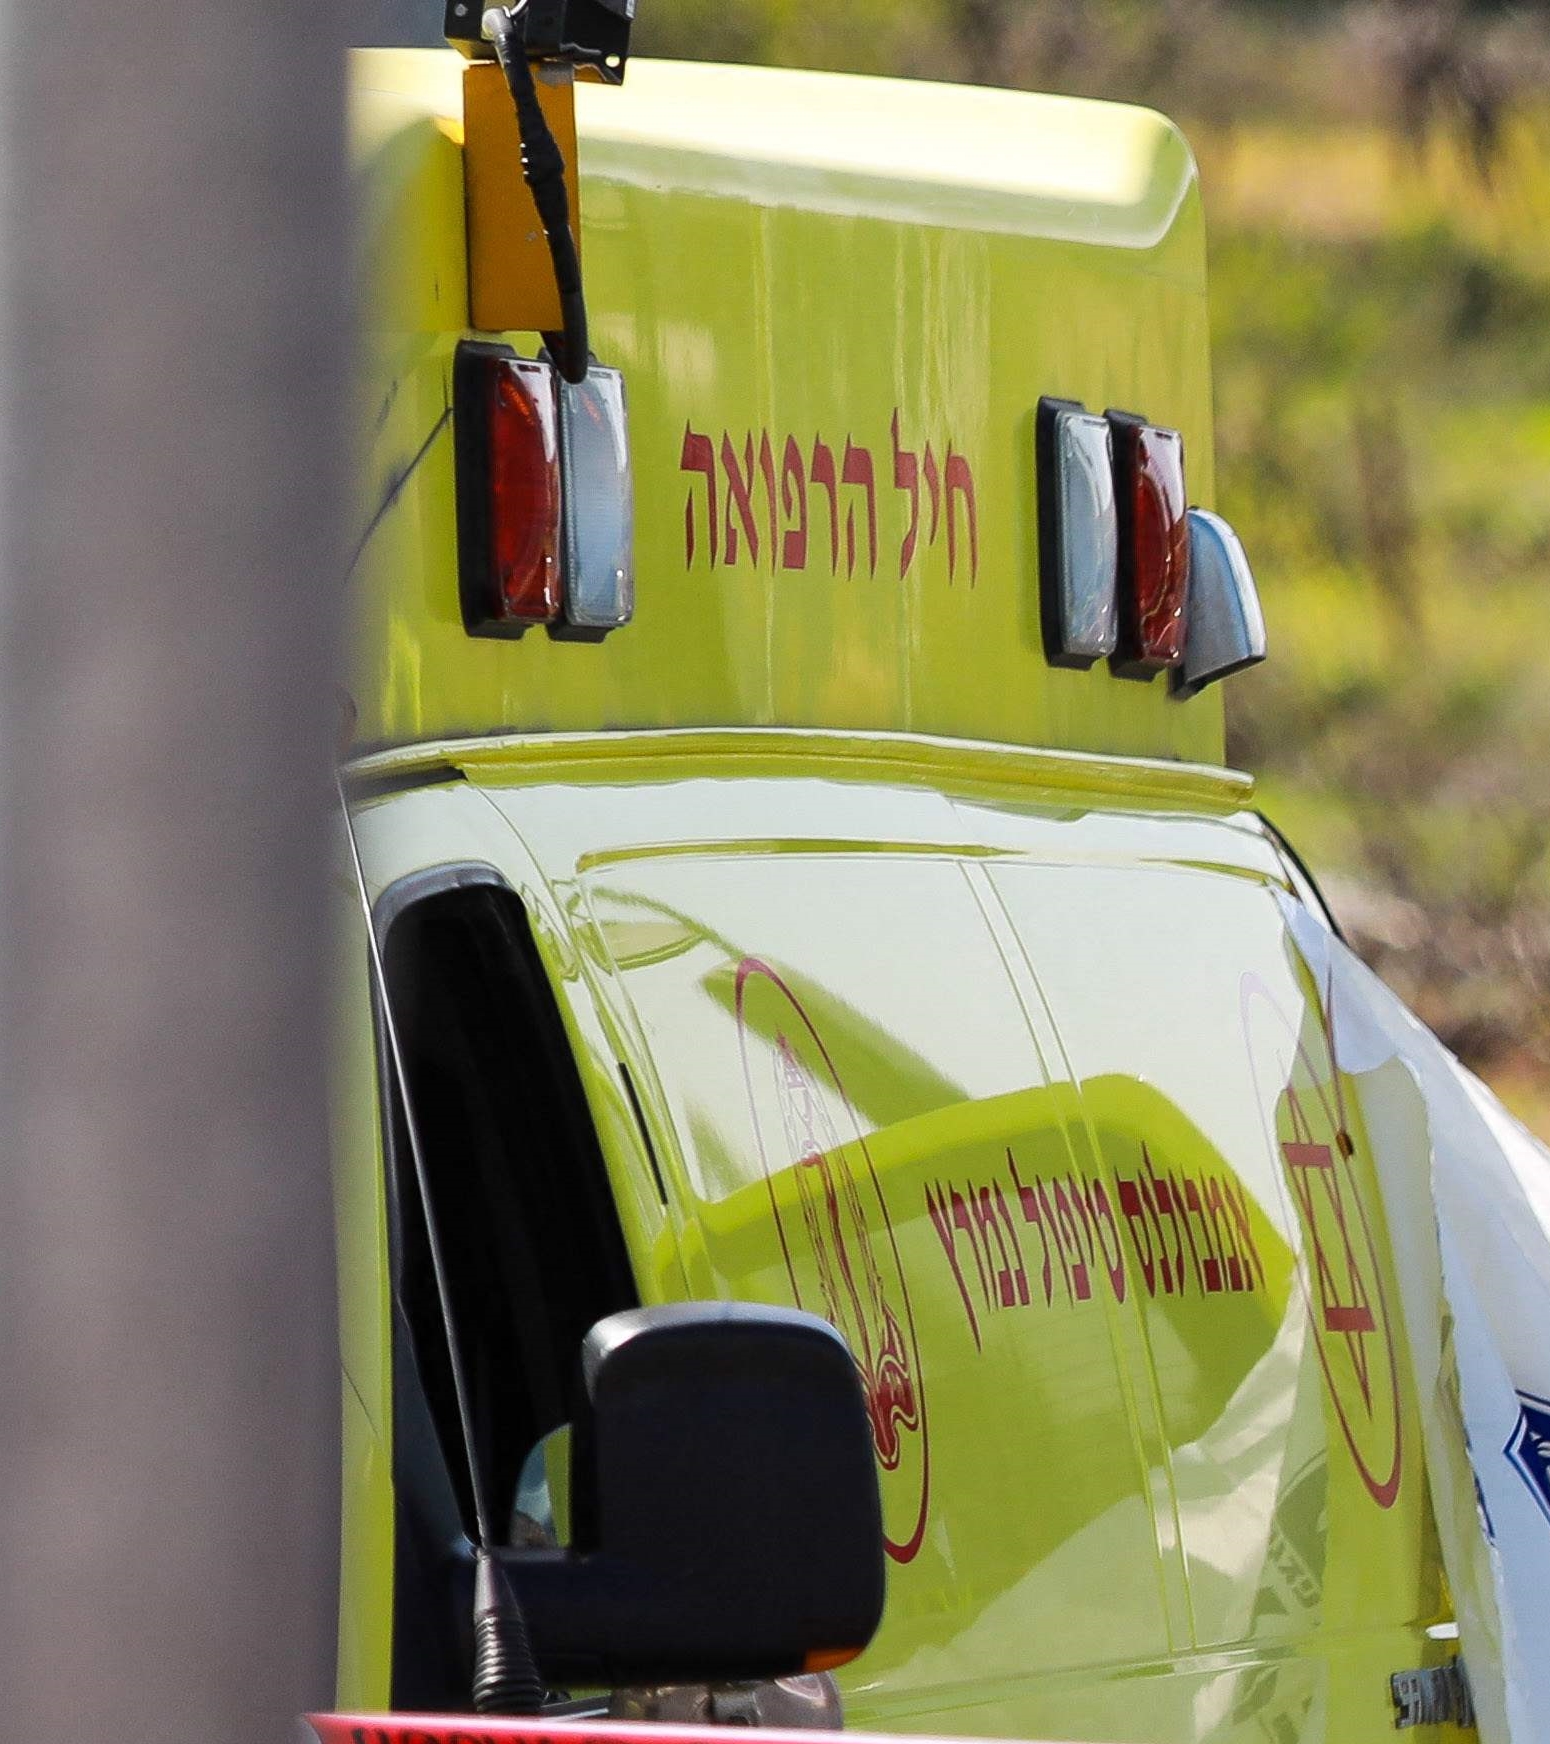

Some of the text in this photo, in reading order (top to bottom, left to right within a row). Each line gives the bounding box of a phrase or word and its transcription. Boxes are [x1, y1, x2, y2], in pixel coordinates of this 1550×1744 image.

[679, 406, 979, 589] חיל הרפואה
[924, 1139, 1266, 1354] אמבולנס טיפול נמרץ
